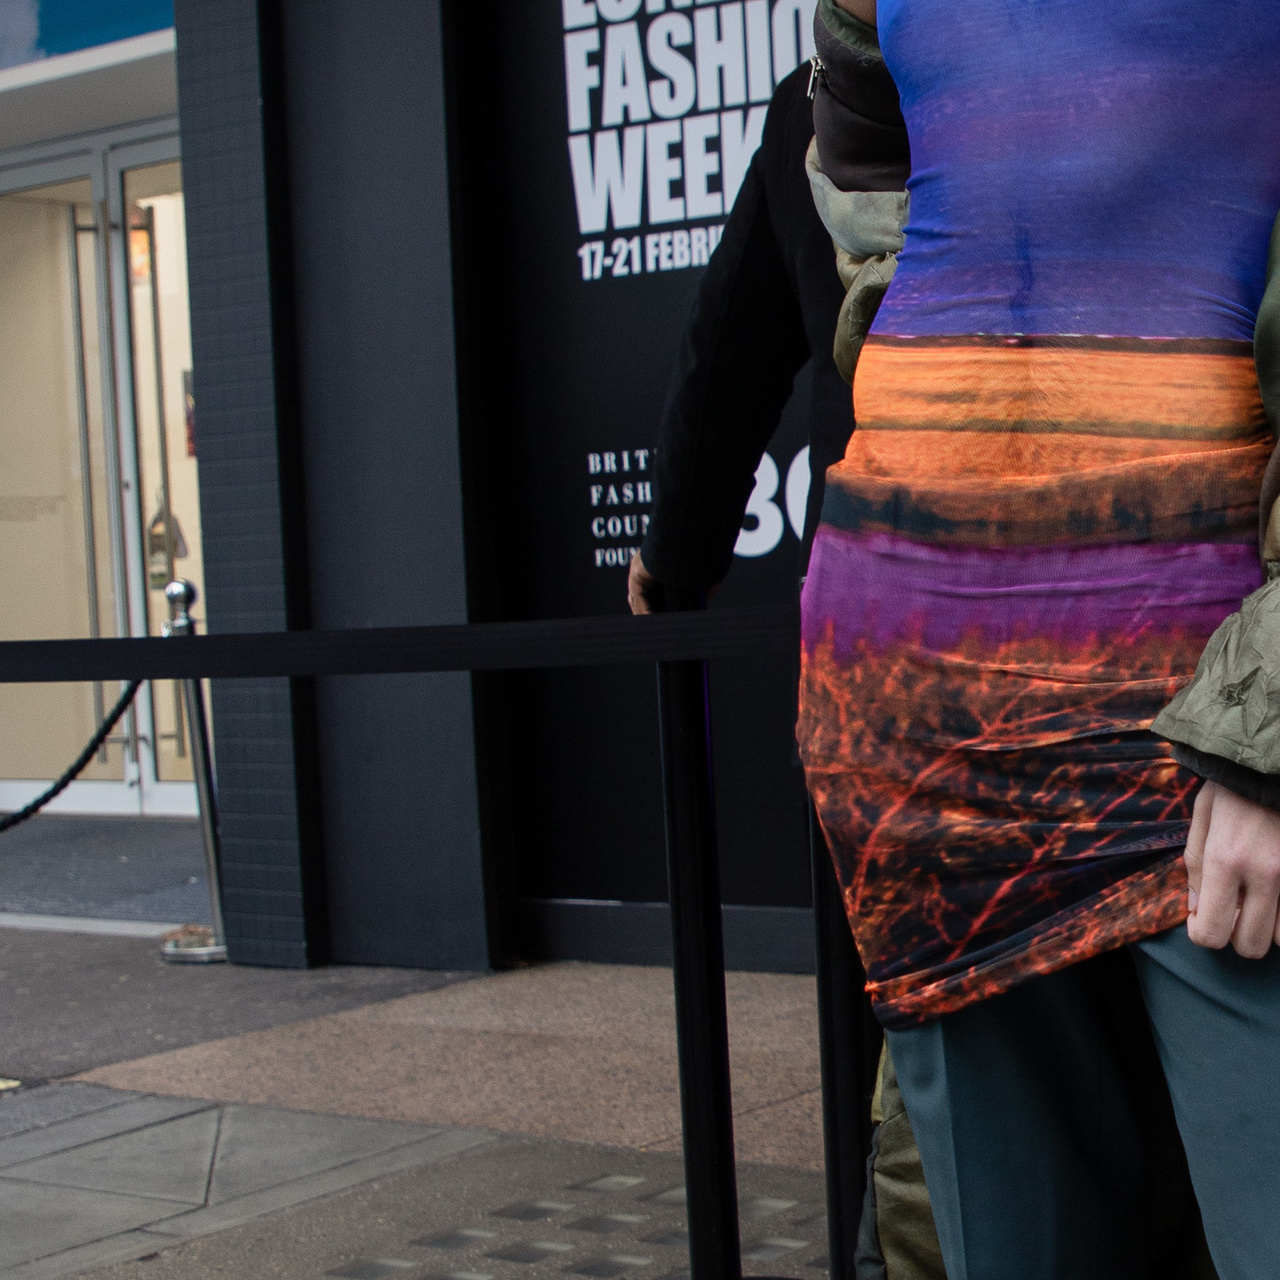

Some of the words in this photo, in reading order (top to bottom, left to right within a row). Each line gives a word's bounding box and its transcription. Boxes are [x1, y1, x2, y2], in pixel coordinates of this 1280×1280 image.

[567, 104, 770, 235] WEEK
[577, 234, 642, 282] 17-21
[587, 448, 657, 475] BRIT
[589, 481, 653, 507] FASH
